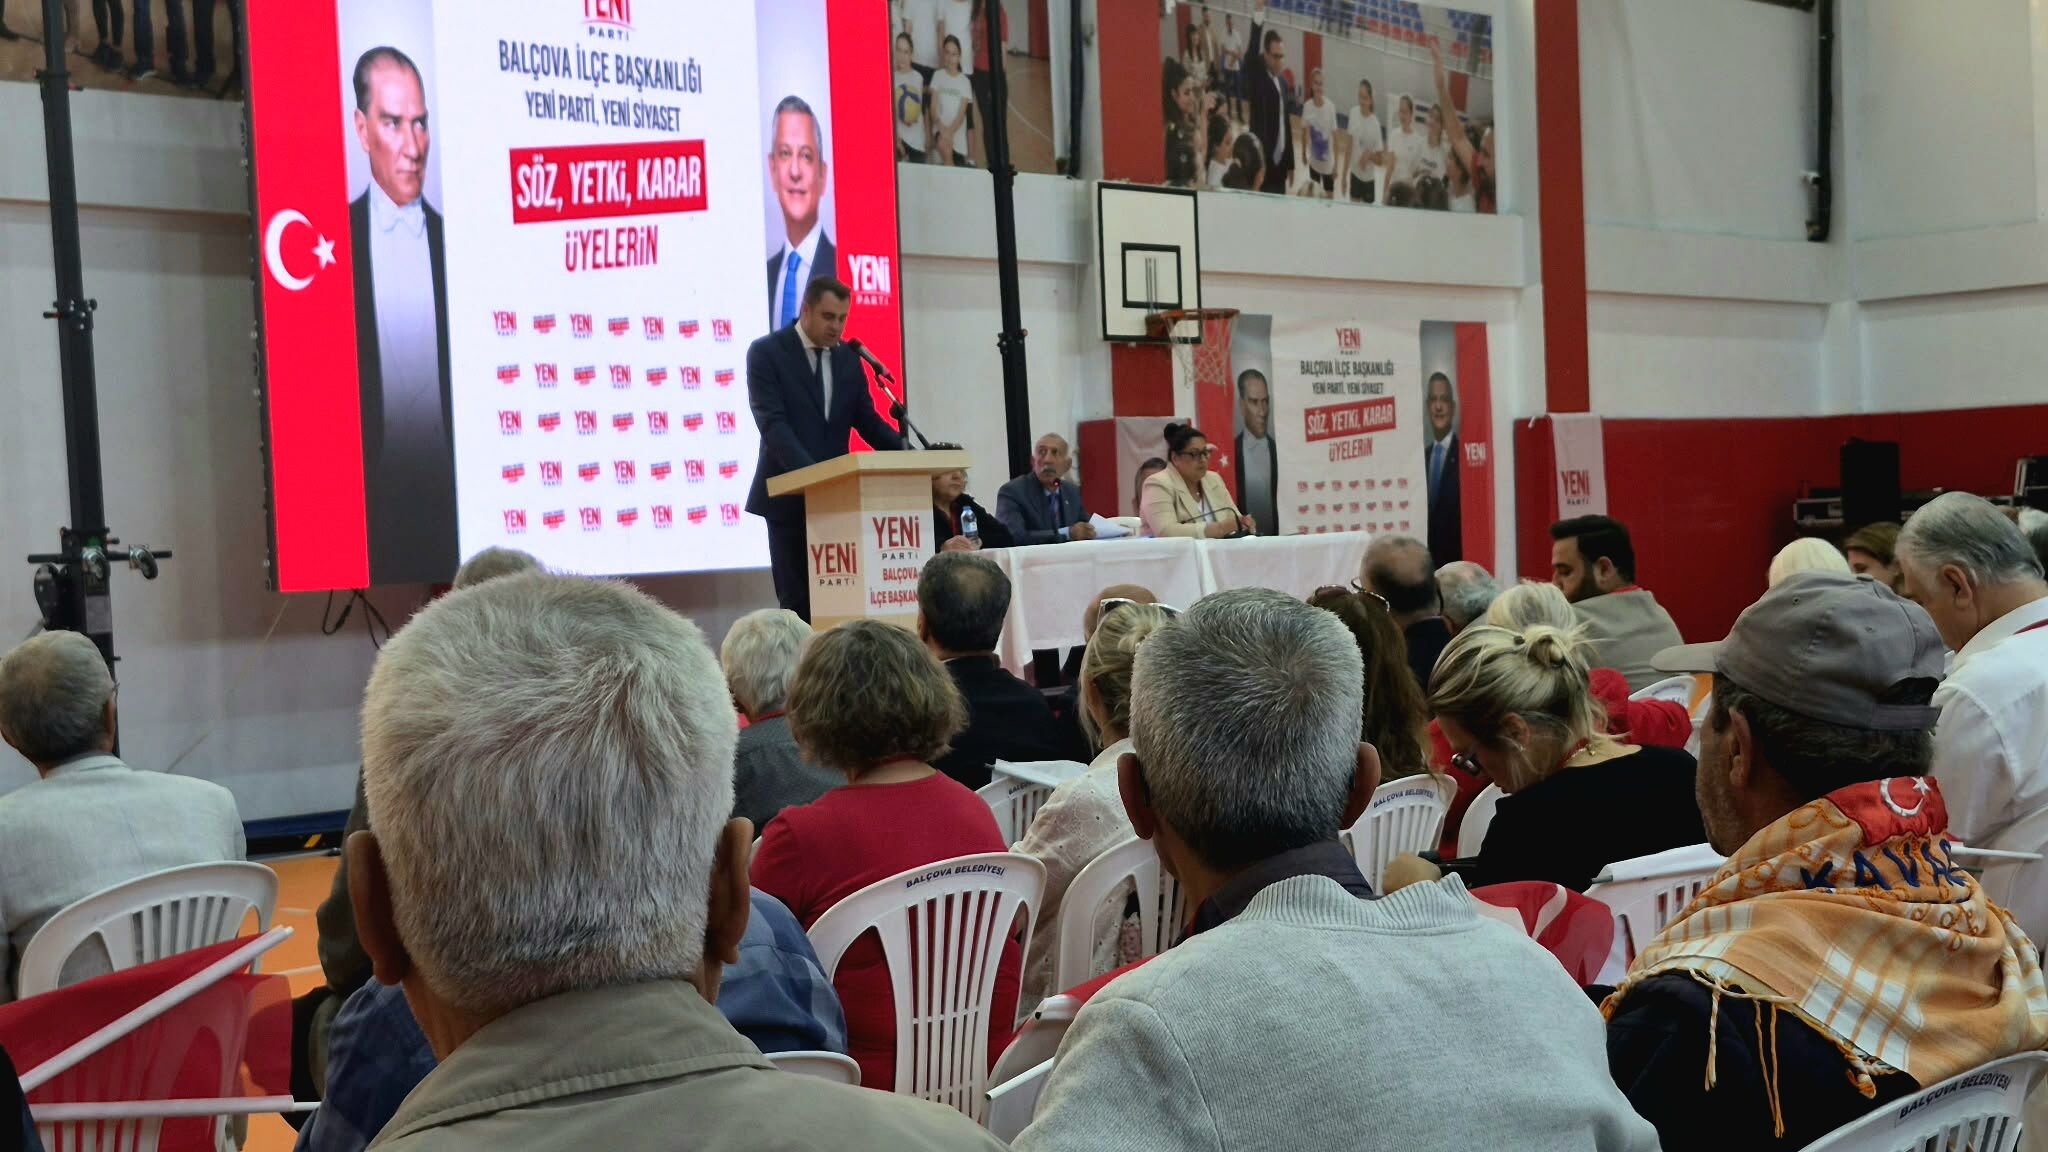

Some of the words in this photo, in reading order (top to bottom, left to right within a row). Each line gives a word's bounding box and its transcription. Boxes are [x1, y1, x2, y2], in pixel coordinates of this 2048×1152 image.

[499, 39, 573, 81] BALÇOVA
[577, 43, 611, 88] İLÇE
[616, 54, 703, 94] BAŞKANLIĞI
[526, 89, 556, 119] YENİ
[559, 93, 599, 127] PARTİ,
[601, 97, 631, 127] YENİ
[633, 98, 681, 132] SİYASET
[517, 153, 563, 213] SÖZ,
[637, 155, 701, 201] KARAR
[1301, 360, 1333, 377] BALÇOVA
[1363, 404, 1393, 427] KARAR
[883, 567, 918, 584] BALÇOVA
[870, 587, 887, 608] İLÇE
[1373, 791, 1404, 808] BALÇOVA
[906, 868, 953, 888] BALÇOVA
[955, 864, 1005, 876] BELEDİYESİ
[1899, 1082, 1957, 1119] BALÇOVA
